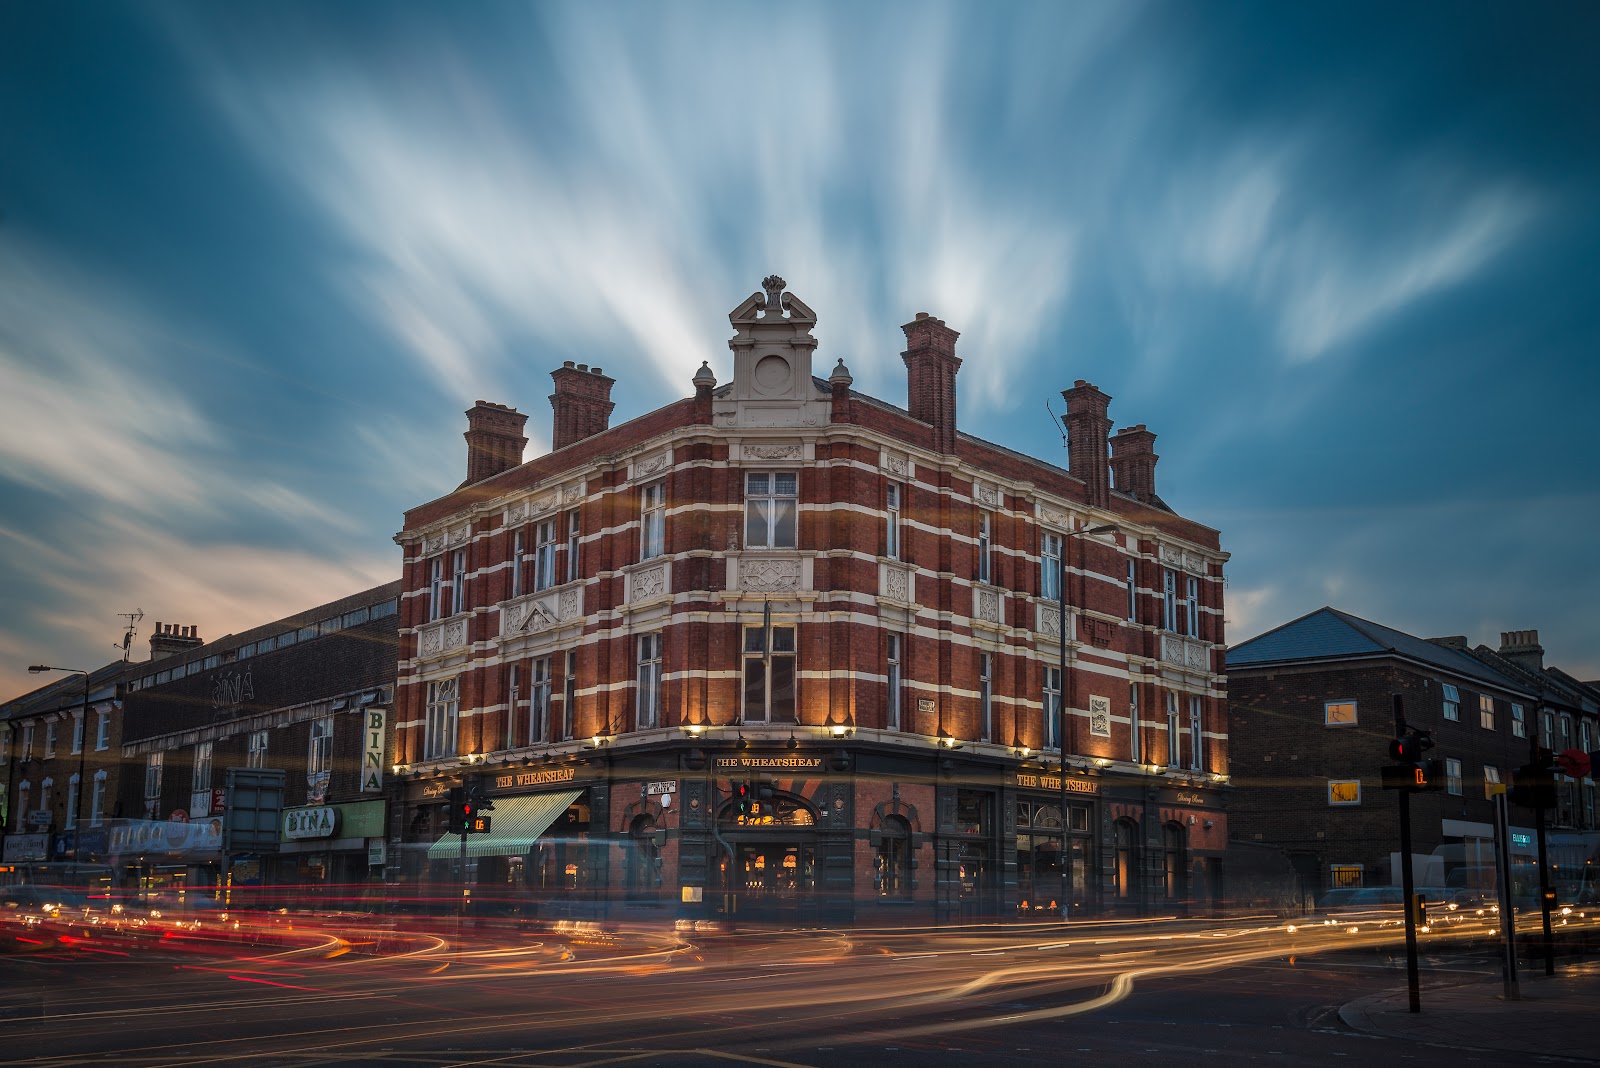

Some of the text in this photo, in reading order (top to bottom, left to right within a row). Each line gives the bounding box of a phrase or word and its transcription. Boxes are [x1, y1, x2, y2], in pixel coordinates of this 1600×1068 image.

[366, 712, 383, 789] BINA
[716, 758, 821, 767] THE WHEATSHEAF
[495, 768, 575, 788] THE WHEATSHEAF
[1016, 774, 1097, 793] THE WHETSHEAF
[1177, 792, 1191, 805] Dining
[288, 812, 331, 832] BINA
